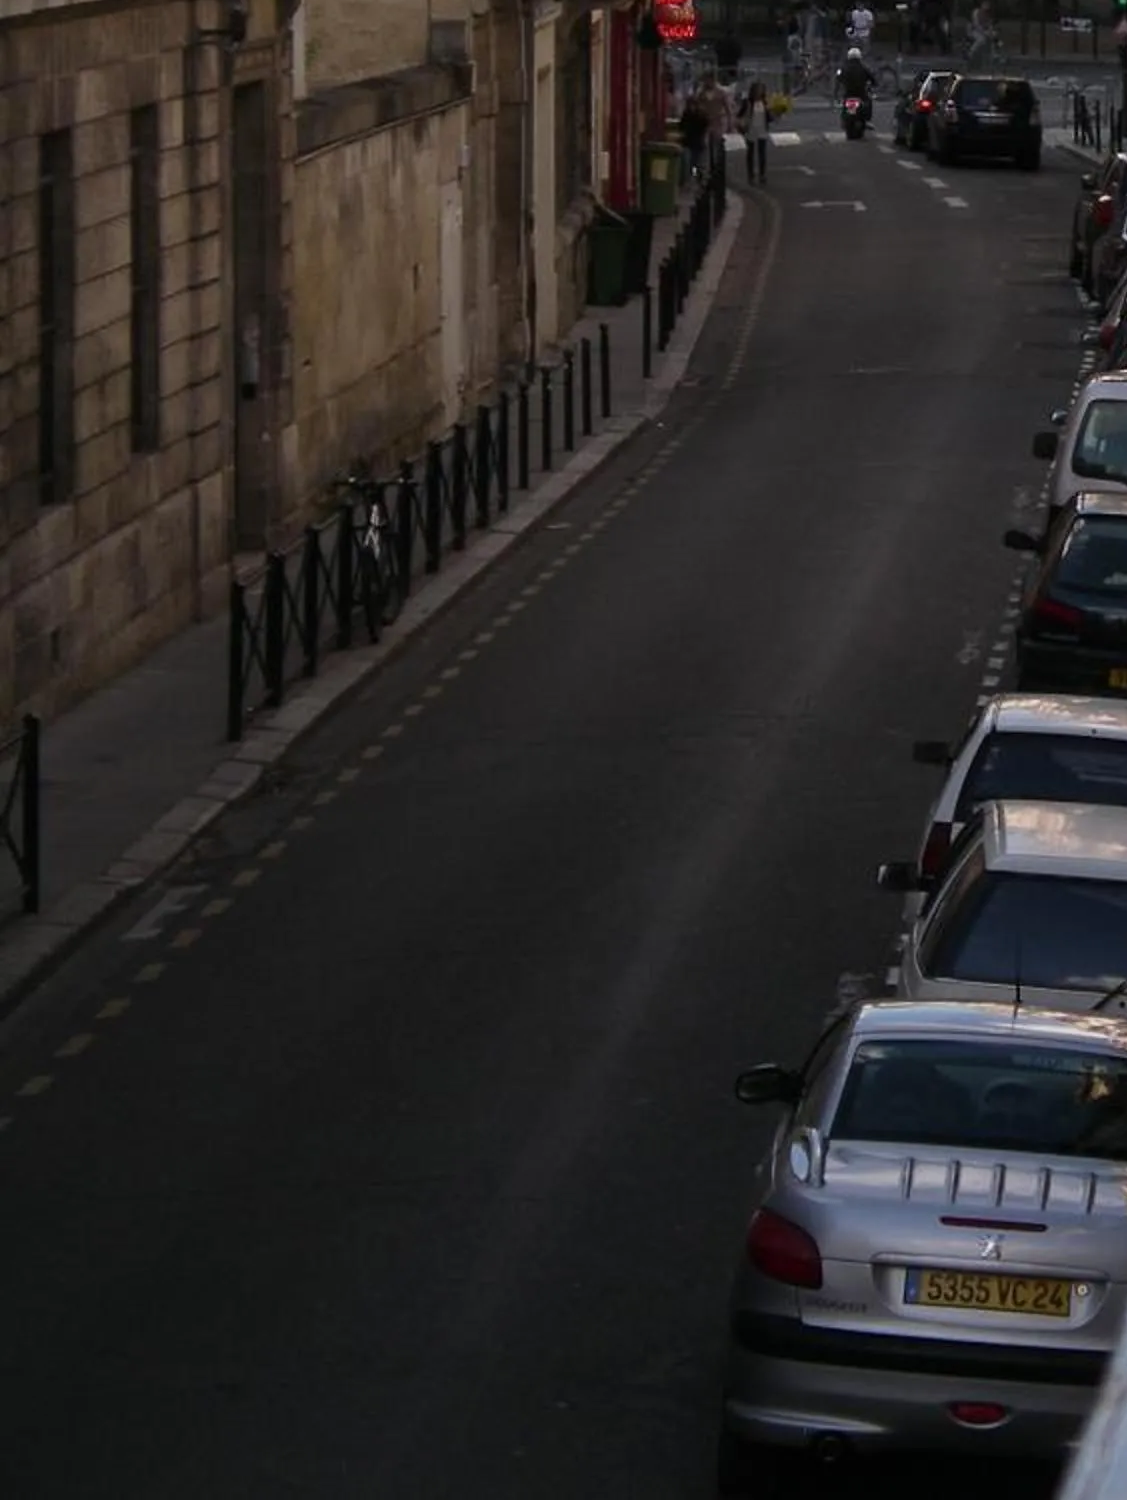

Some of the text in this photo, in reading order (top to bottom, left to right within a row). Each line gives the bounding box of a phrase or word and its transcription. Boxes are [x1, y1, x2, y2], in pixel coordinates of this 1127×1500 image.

[926, 1273, 1065, 1311] 5355 VC 24
